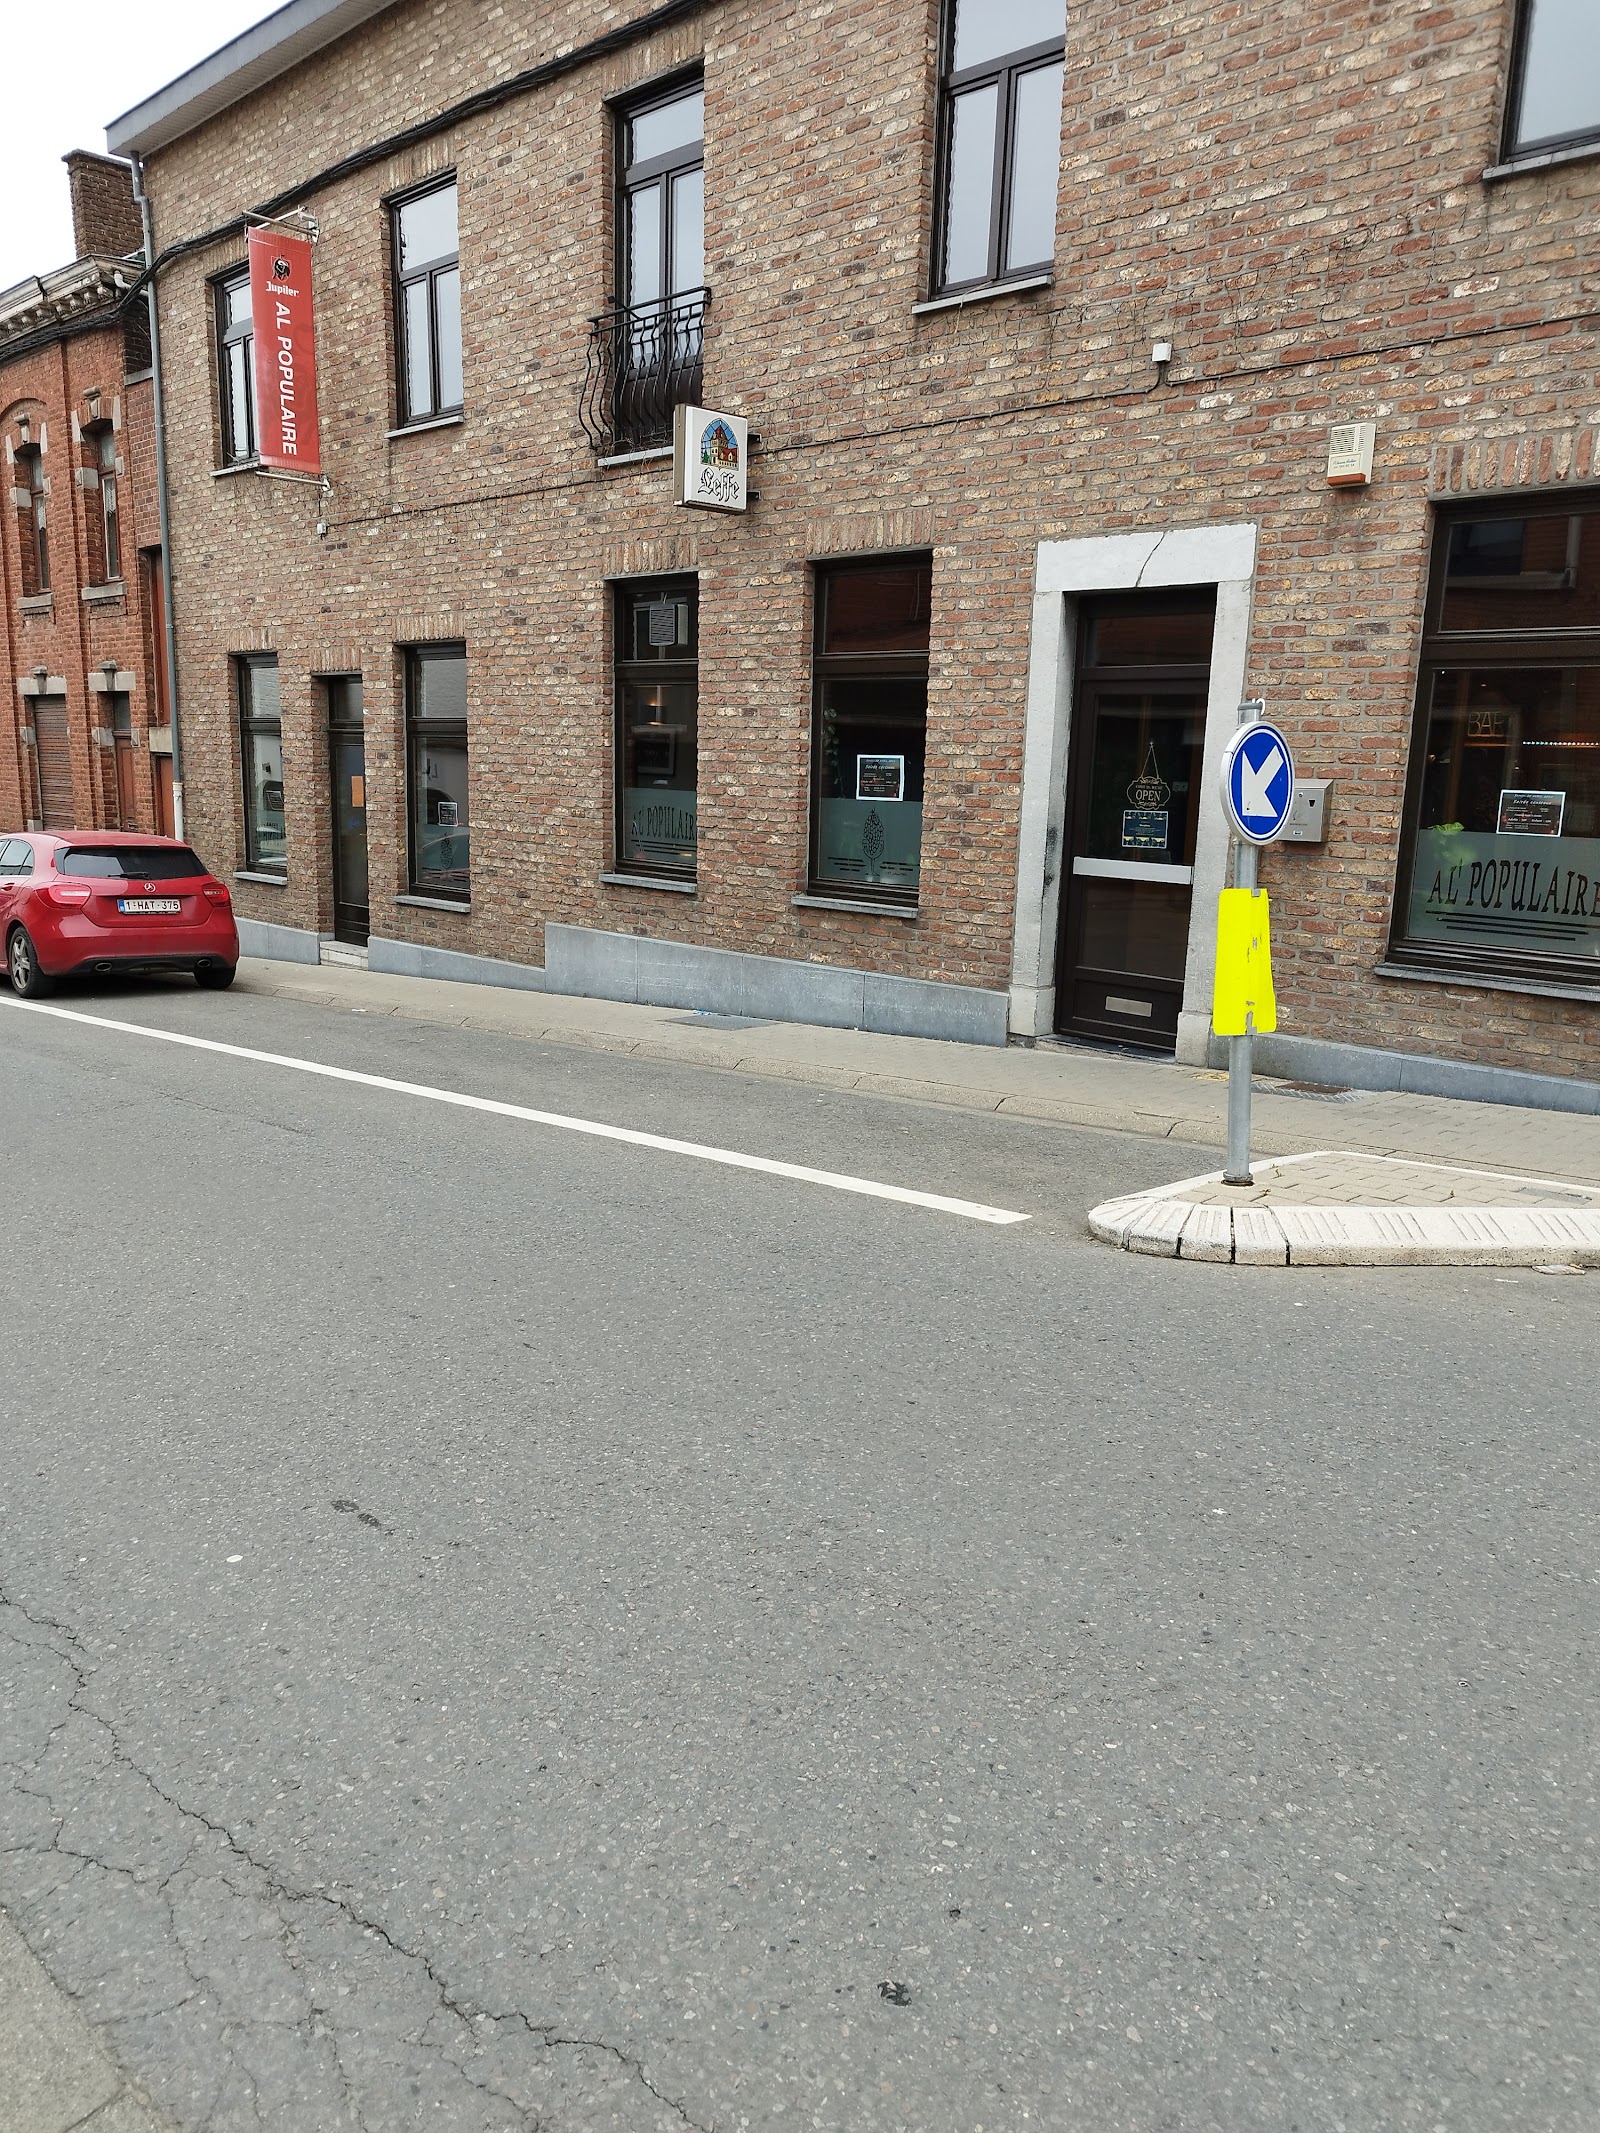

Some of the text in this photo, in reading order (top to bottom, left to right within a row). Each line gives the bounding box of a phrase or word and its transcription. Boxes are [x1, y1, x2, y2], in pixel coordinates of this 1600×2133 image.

[265, 281, 300, 297] Jupiler
[275, 301, 298, 456] AL POPULAIRE
[697, 467, 740, 502] Leffe
[1467, 711, 1504, 736] BAR
[1135, 789, 1162, 801] OPEN
[646, 805, 697, 841] POPULAIR
